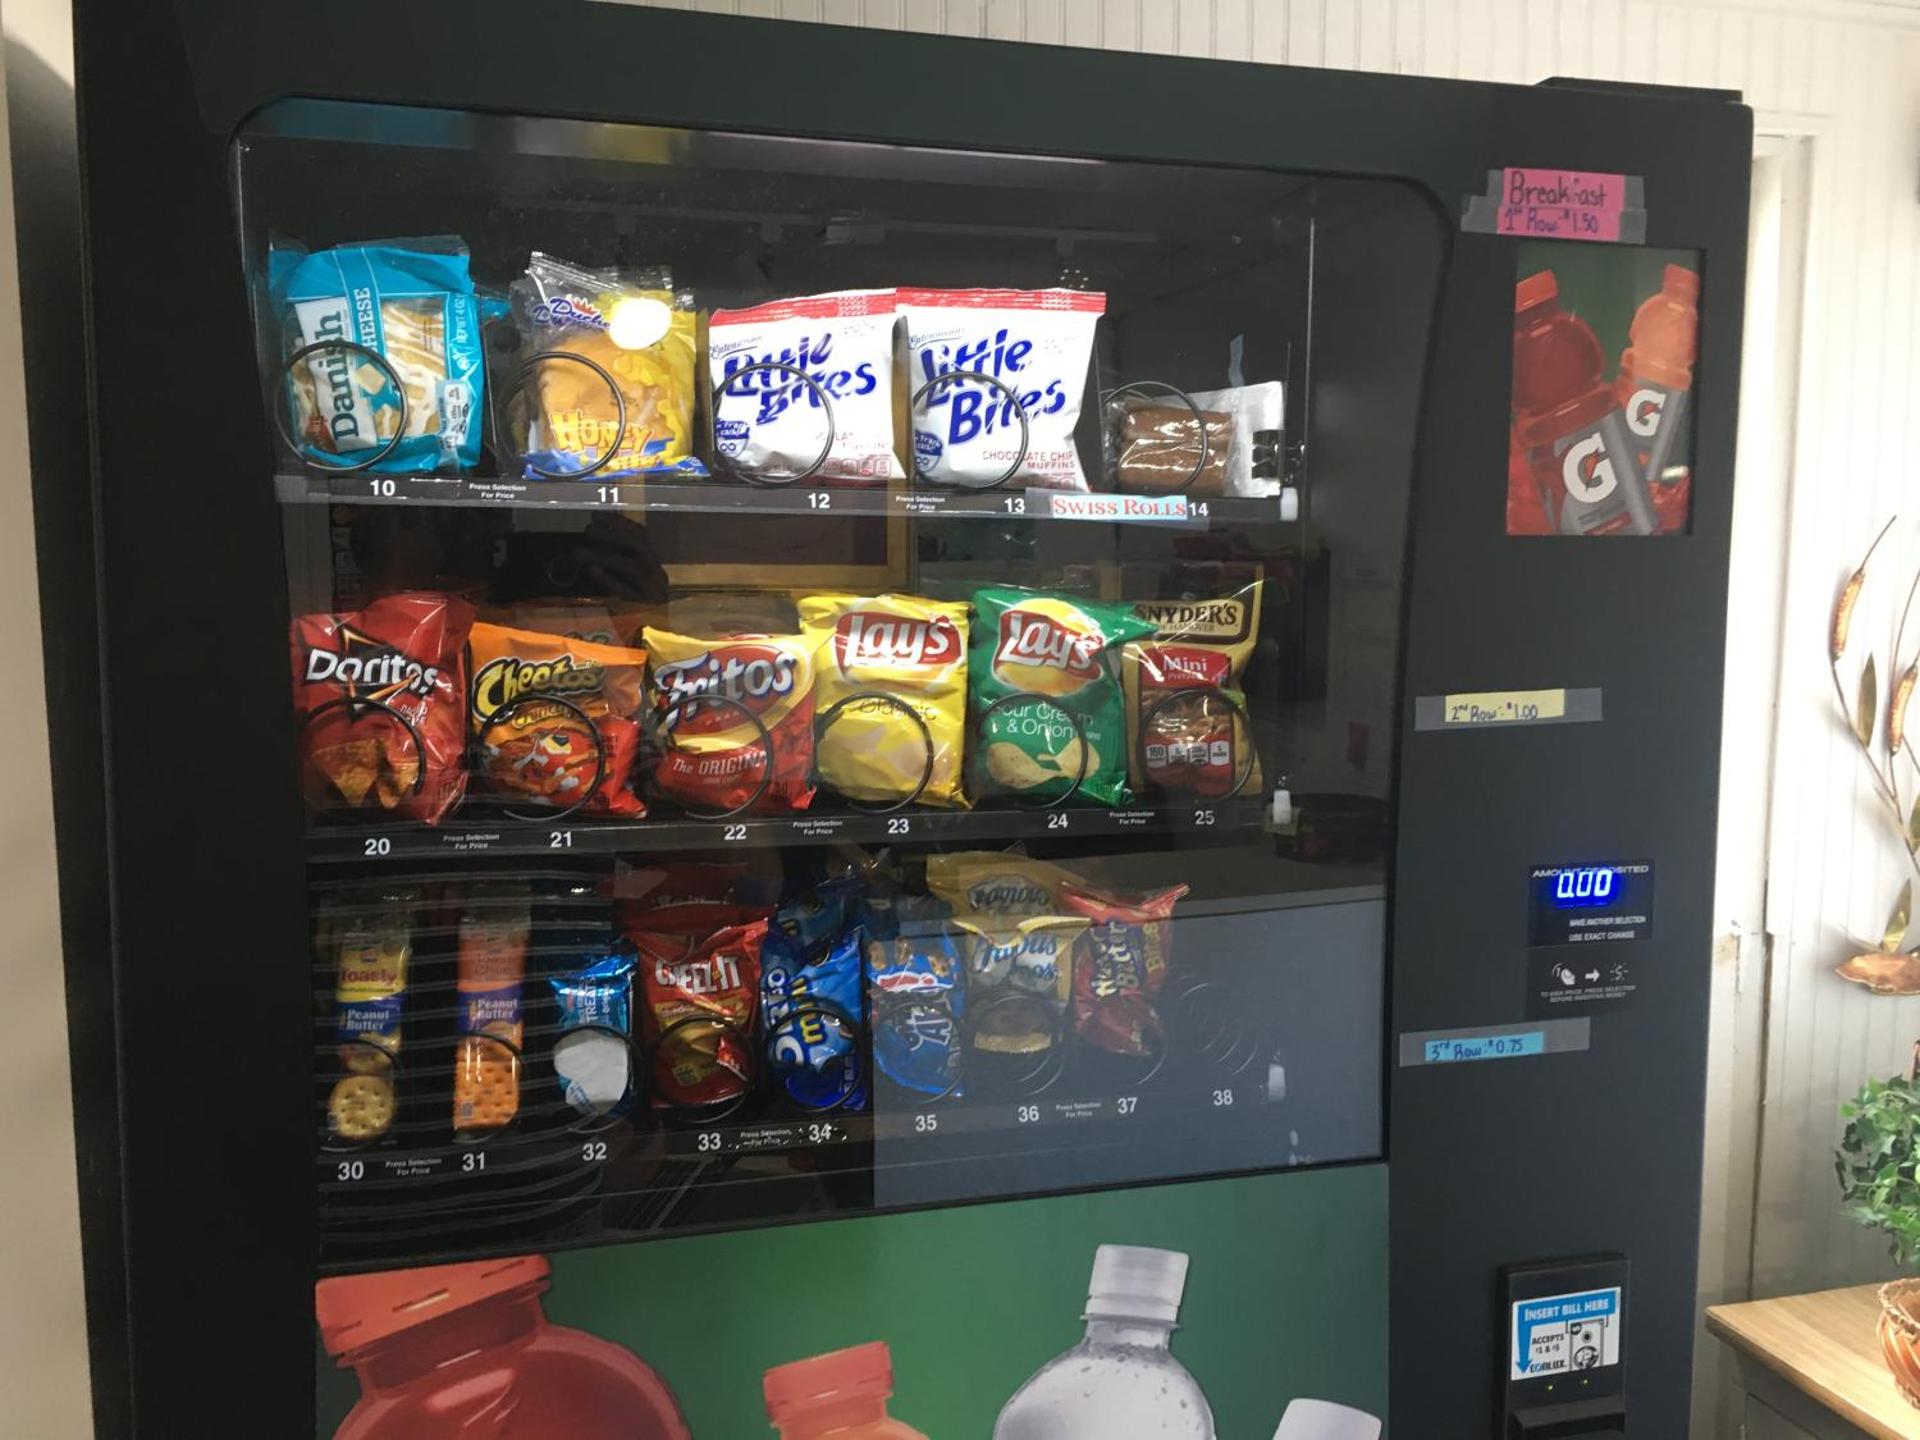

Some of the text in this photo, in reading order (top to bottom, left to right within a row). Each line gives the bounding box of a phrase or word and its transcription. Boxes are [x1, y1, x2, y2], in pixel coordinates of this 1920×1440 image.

[354, 287, 378, 351] HEESE
[948, 379, 1066, 445] Bites
[982, 449, 1046, 462] CHOCOATE
[369, 479, 396, 497] 10
[469, 483, 527, 492] Press Selection
[481, 491, 495, 499] For
[597, 487, 619, 503] 11
[807, 492, 831, 510] 12
[1003, 497, 1026, 514] 13
[1188, 502, 1209, 517] 14
[306, 648, 438, 694] Doritos
[1163, 655, 1208, 671] Mini
[654, 650, 797, 728] Fritos
[1022, 718, 1073, 738] Onion
[673, 758, 693, 774] The
[887, 818, 910, 834] 23
[1047, 813, 1069, 829] 24
[1194, 810, 1215, 825] 25
[550, 831, 572, 848] 21
[724, 824, 747, 841] 22
[364, 838, 391, 855] 20
[1557, 870, 1613, 898] 0.00
[1584, 932, 1606, 940] EXACT
[342, 968, 397, 986] Toasty
[478, 998, 518, 1009] Peanut
[347, 1009, 390, 1020] Peanut
[478, 1009, 514, 1020] Butter
[346, 1020, 386, 1031] Butter
[1117, 1097, 1138, 1114] 37
[1212, 1089, 1234, 1106] 38
[1017, 1105, 1040, 1122] 36
[915, 1114, 937, 1132] 35
[808, 1123, 832, 1141] 34
[698, 1132, 722, 1150] 33
[582, 1142, 607, 1161] 32
[462, 1152, 485, 1172] 31
[337, 1161, 364, 1181] 30
[1524, 1298, 1609, 1321] INSERT BILL HERE
[1532, 1333, 1564, 1345] ACCEPTS
